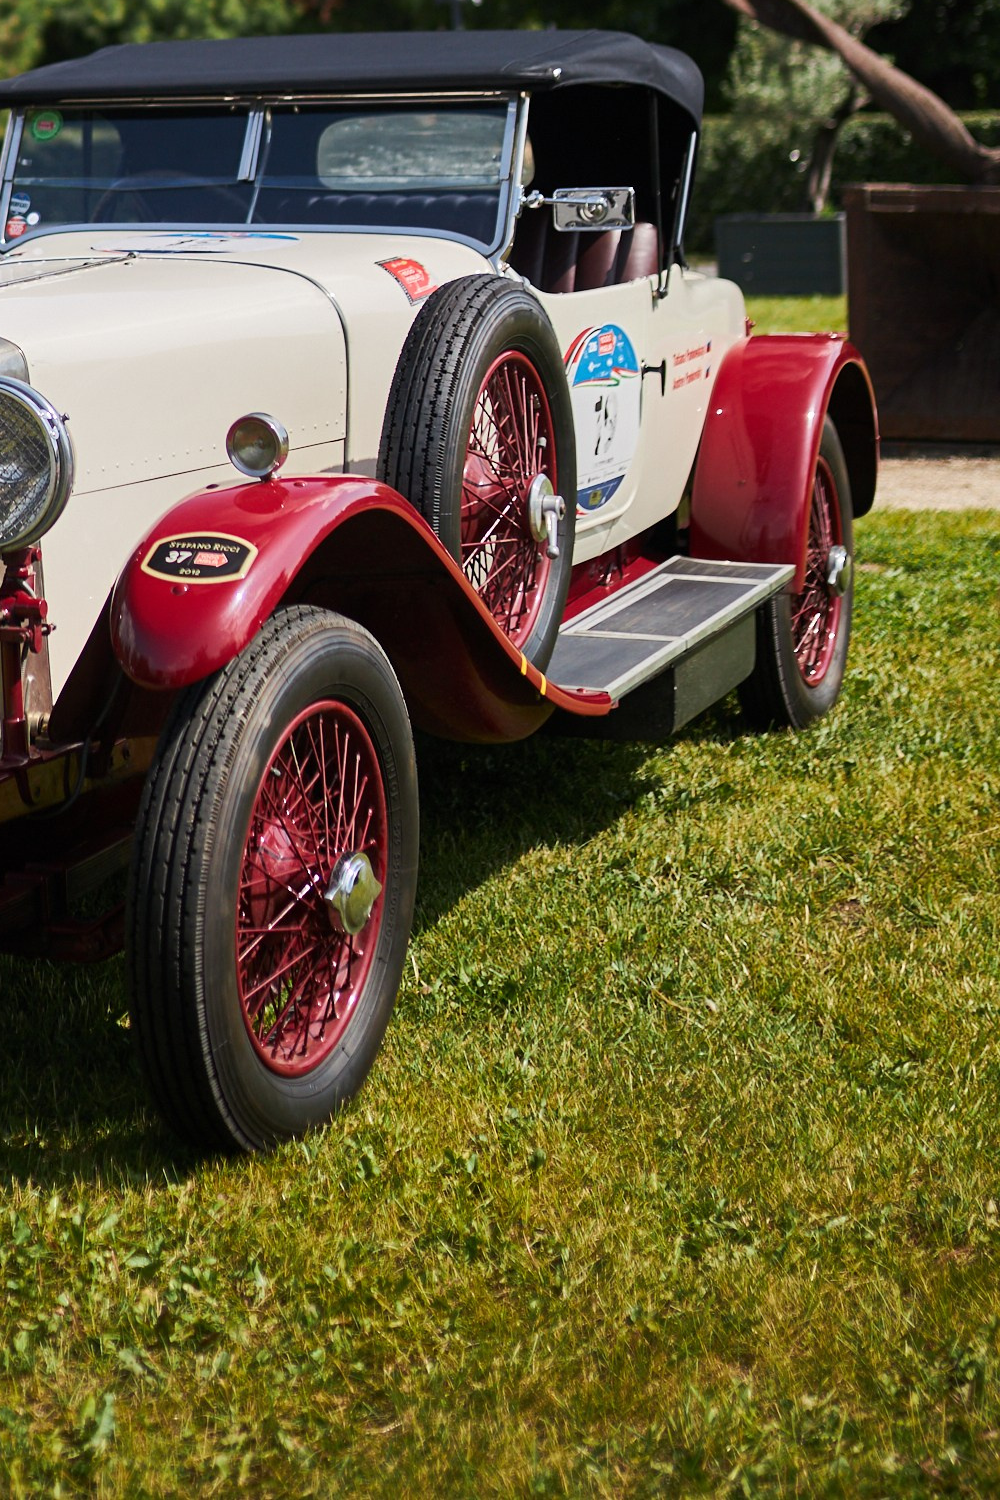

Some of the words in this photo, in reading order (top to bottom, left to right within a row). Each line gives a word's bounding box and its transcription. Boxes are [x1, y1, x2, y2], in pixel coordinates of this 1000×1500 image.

[169, 541, 212, 550] STEFANO
[213, 543, 241, 553] RICCI
[165, 550, 192, 563] 37
